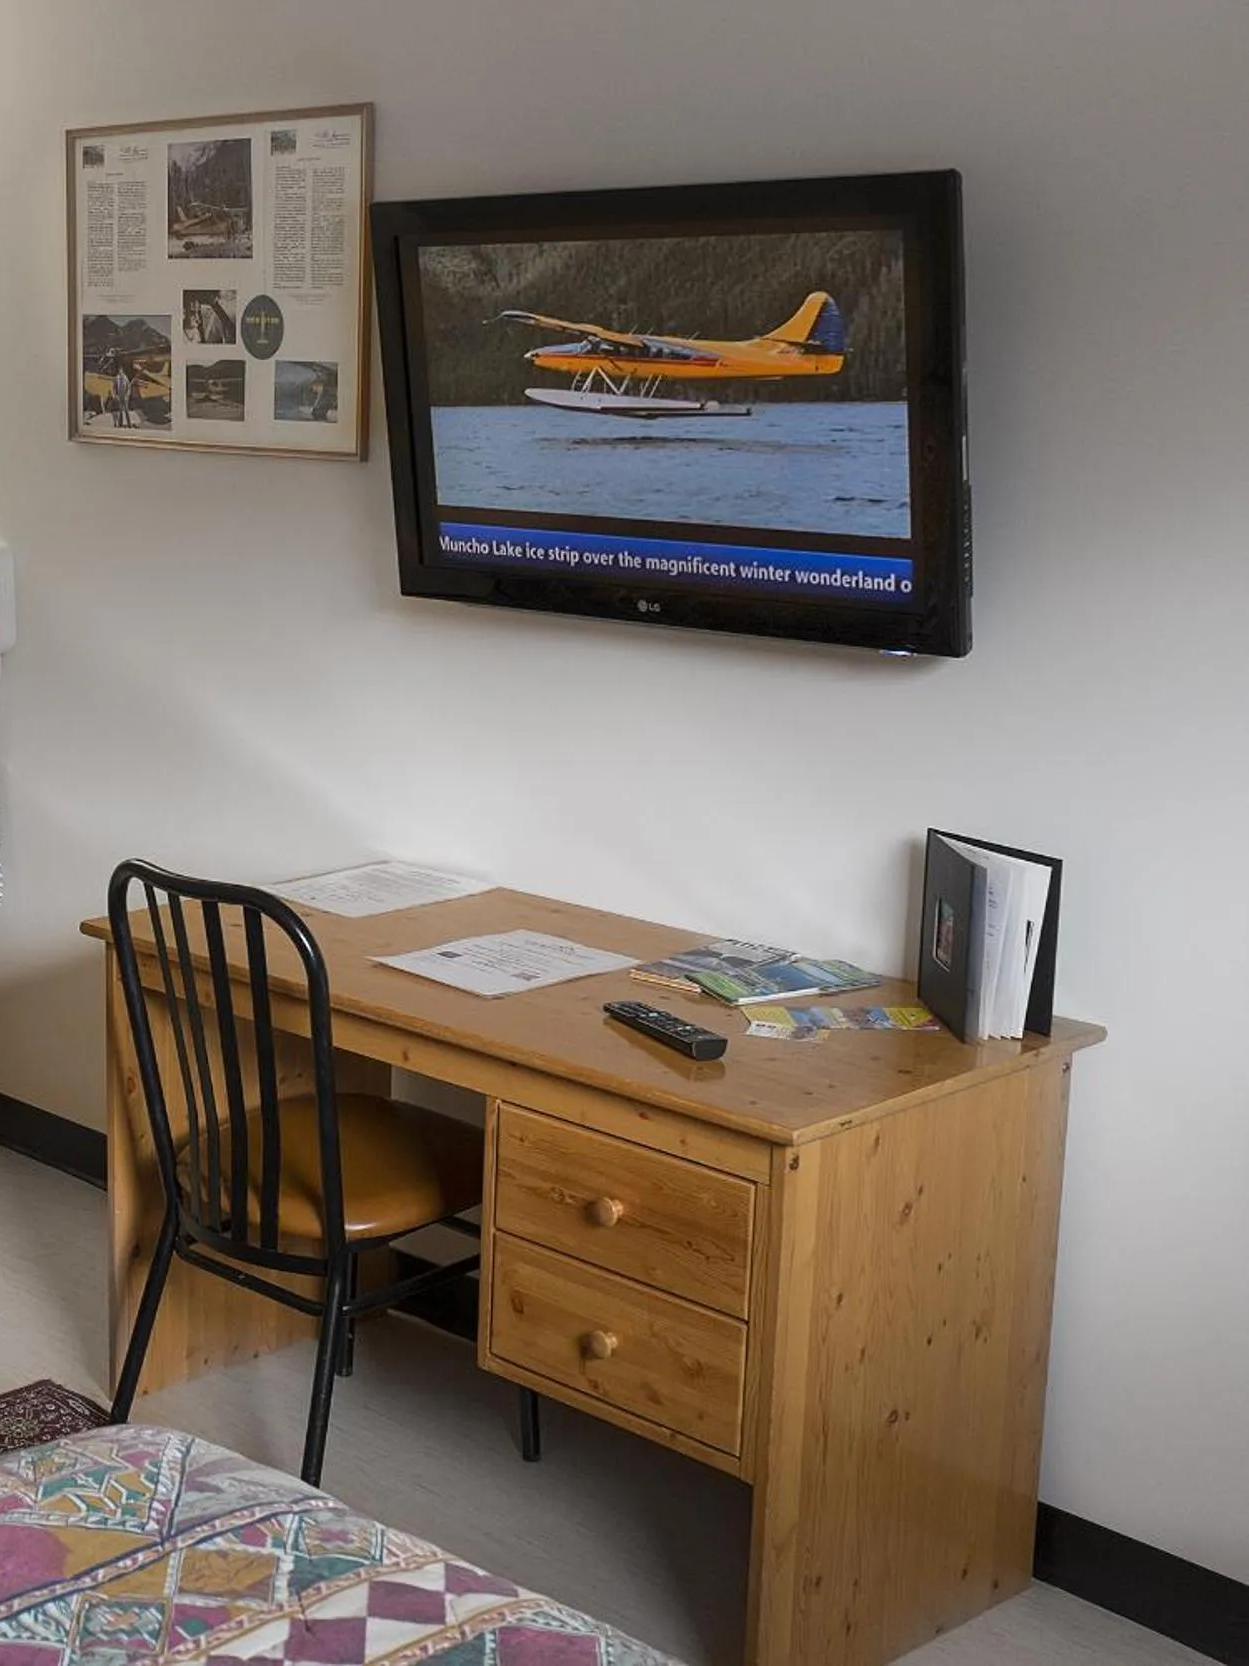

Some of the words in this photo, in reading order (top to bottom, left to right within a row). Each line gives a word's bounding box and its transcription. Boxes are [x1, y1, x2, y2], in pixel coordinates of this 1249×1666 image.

[493, 541, 521, 557] Lake
[526, 543, 544, 559] ice
[549, 546, 579, 566] strip
[583, 550, 614, 565] over
[617, 551, 641, 568] the
[646, 556, 736, 577] magnificent
[740, 561, 790, 582] winter
[795, 568, 896, 592] wonderland
